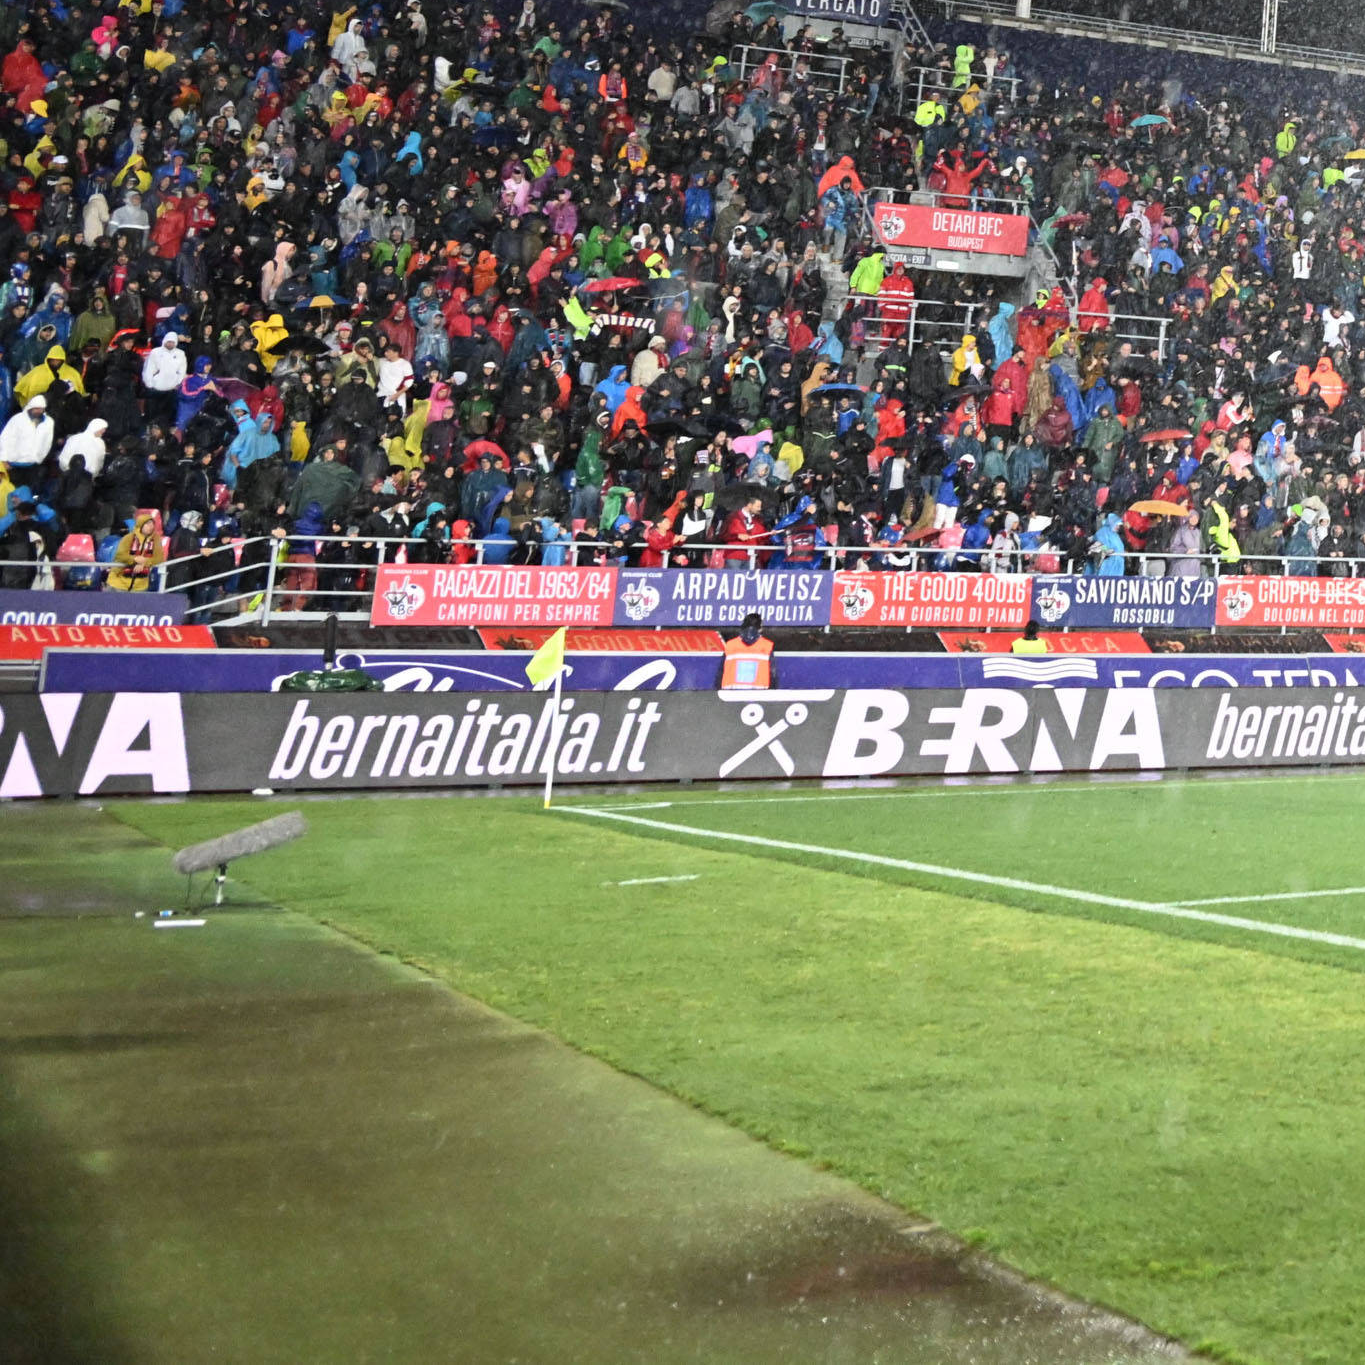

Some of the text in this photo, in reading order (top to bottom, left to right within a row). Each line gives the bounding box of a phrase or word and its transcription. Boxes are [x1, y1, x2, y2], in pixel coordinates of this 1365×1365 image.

[932, 211, 1004, 237] DETARI BFC
[947, 235, 985, 250] BUDAPEST
[432, 569, 611, 600] RAGAZZI DEL 1963/64
[672, 572, 824, 601] ARPAD WEISZ
[882, 575, 1027, 604] THE GOOD 40016
[1257, 579, 1320, 604] GRUPPO
[437, 603, 600, 622] CAMPIONI PER SEMPRE
[677, 604, 713, 622] CLUB
[879, 605, 1024, 624] SAN GIORGIO DI PIANO
[1112, 608, 1175, 624] ROSSOBLU
[1263, 607, 1314, 623] BOLOGNA
[1318, 608, 1339, 624] NEL
[11, 625, 185, 644] ALTO RENO
[639, 635, 721, 652] EMILIA
[268, 698, 663, 781] bernaitalia.it
[822, 687, 1167, 777] BERNA
